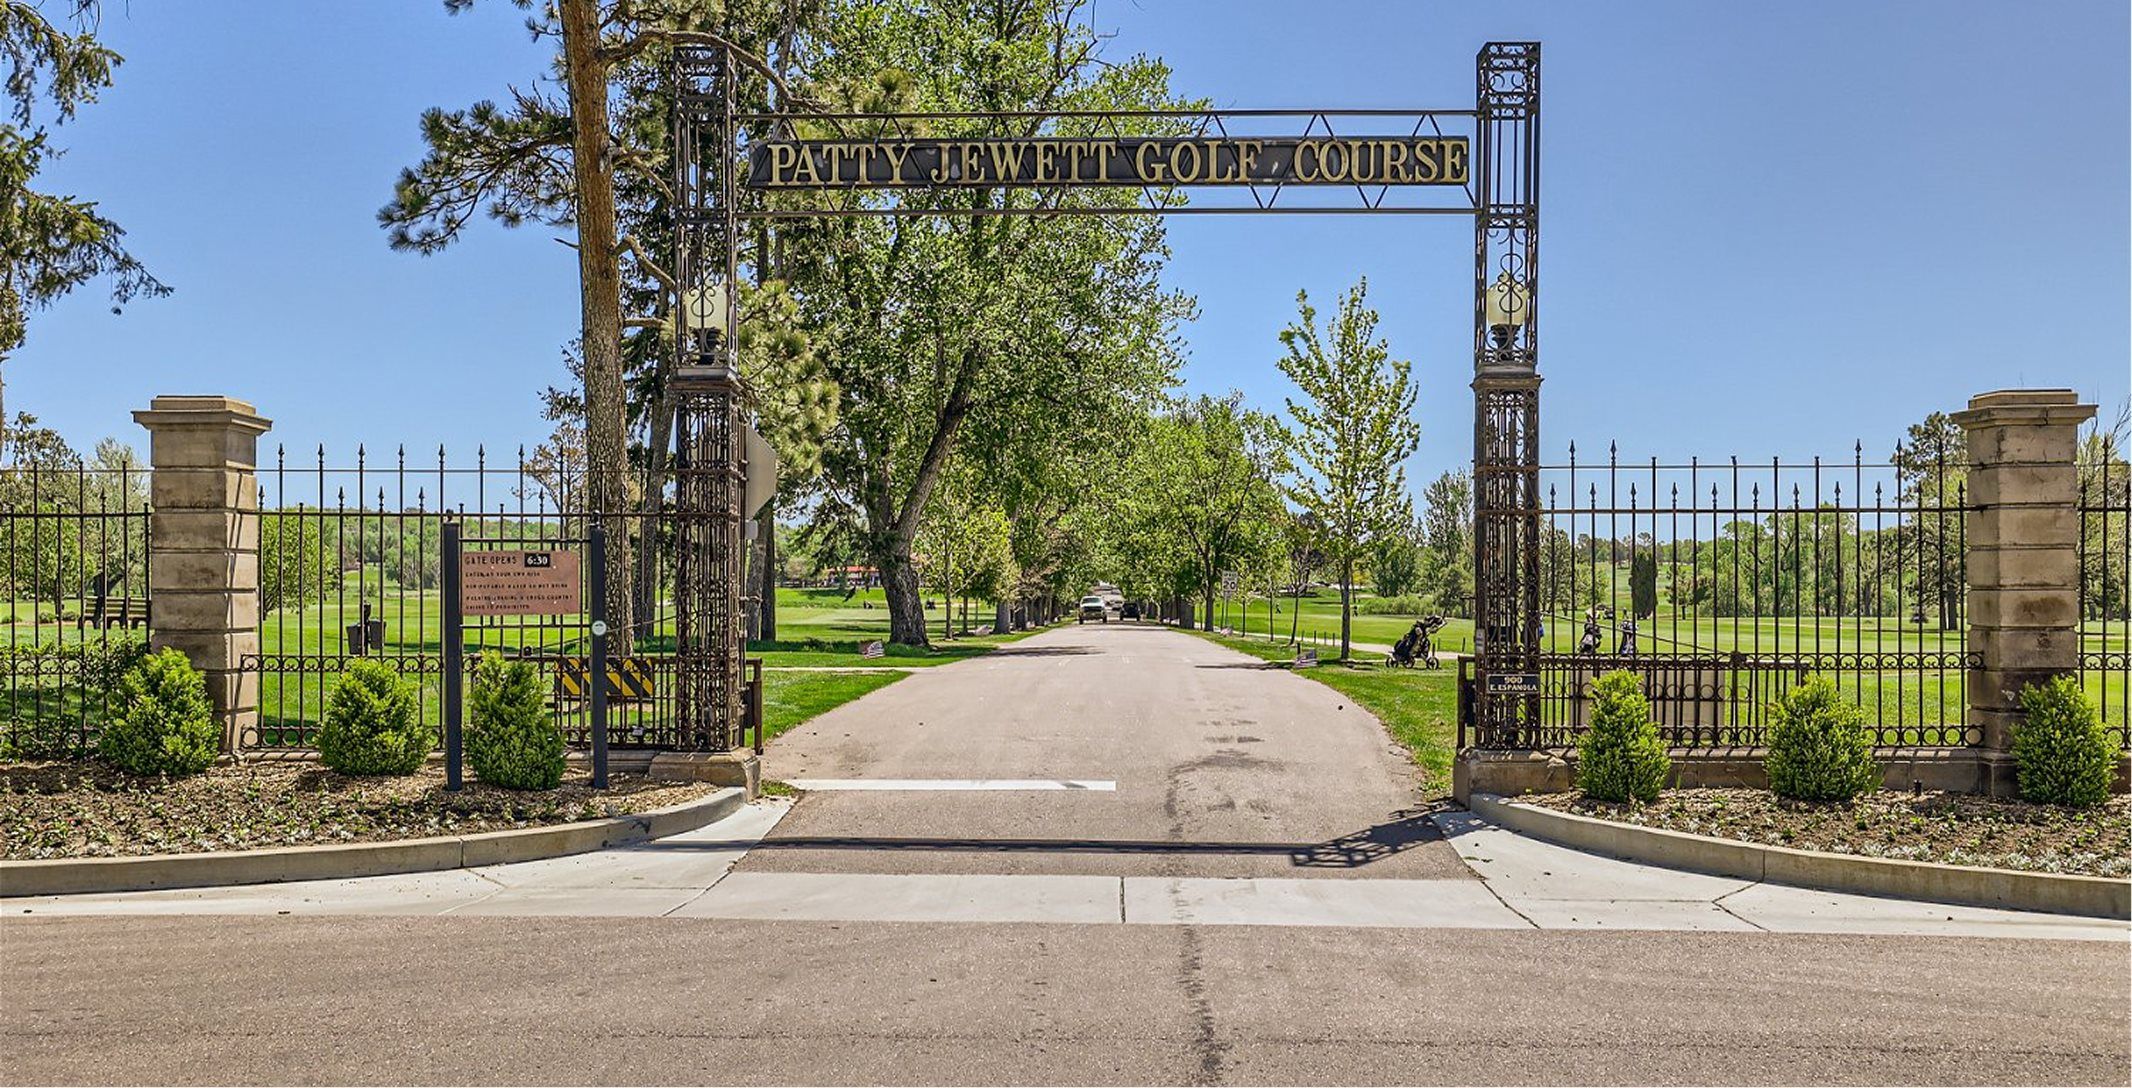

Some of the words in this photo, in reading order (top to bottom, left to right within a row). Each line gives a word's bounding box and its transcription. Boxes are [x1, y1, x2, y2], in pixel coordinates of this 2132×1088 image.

[768, 143, 912, 187] PATTY
[930, 142, 1117, 185] JEWETT
[1136, 140, 1262, 184] GOLF
[1294, 139, 1468, 184] COURSE
[465, 556, 487, 565] GATE
[490, 556, 517, 565] OPENS
[526, 556, 548, 565] 6:30
[1223, 580, 1236, 590] 20
[1504, 676, 1523, 684] 900
